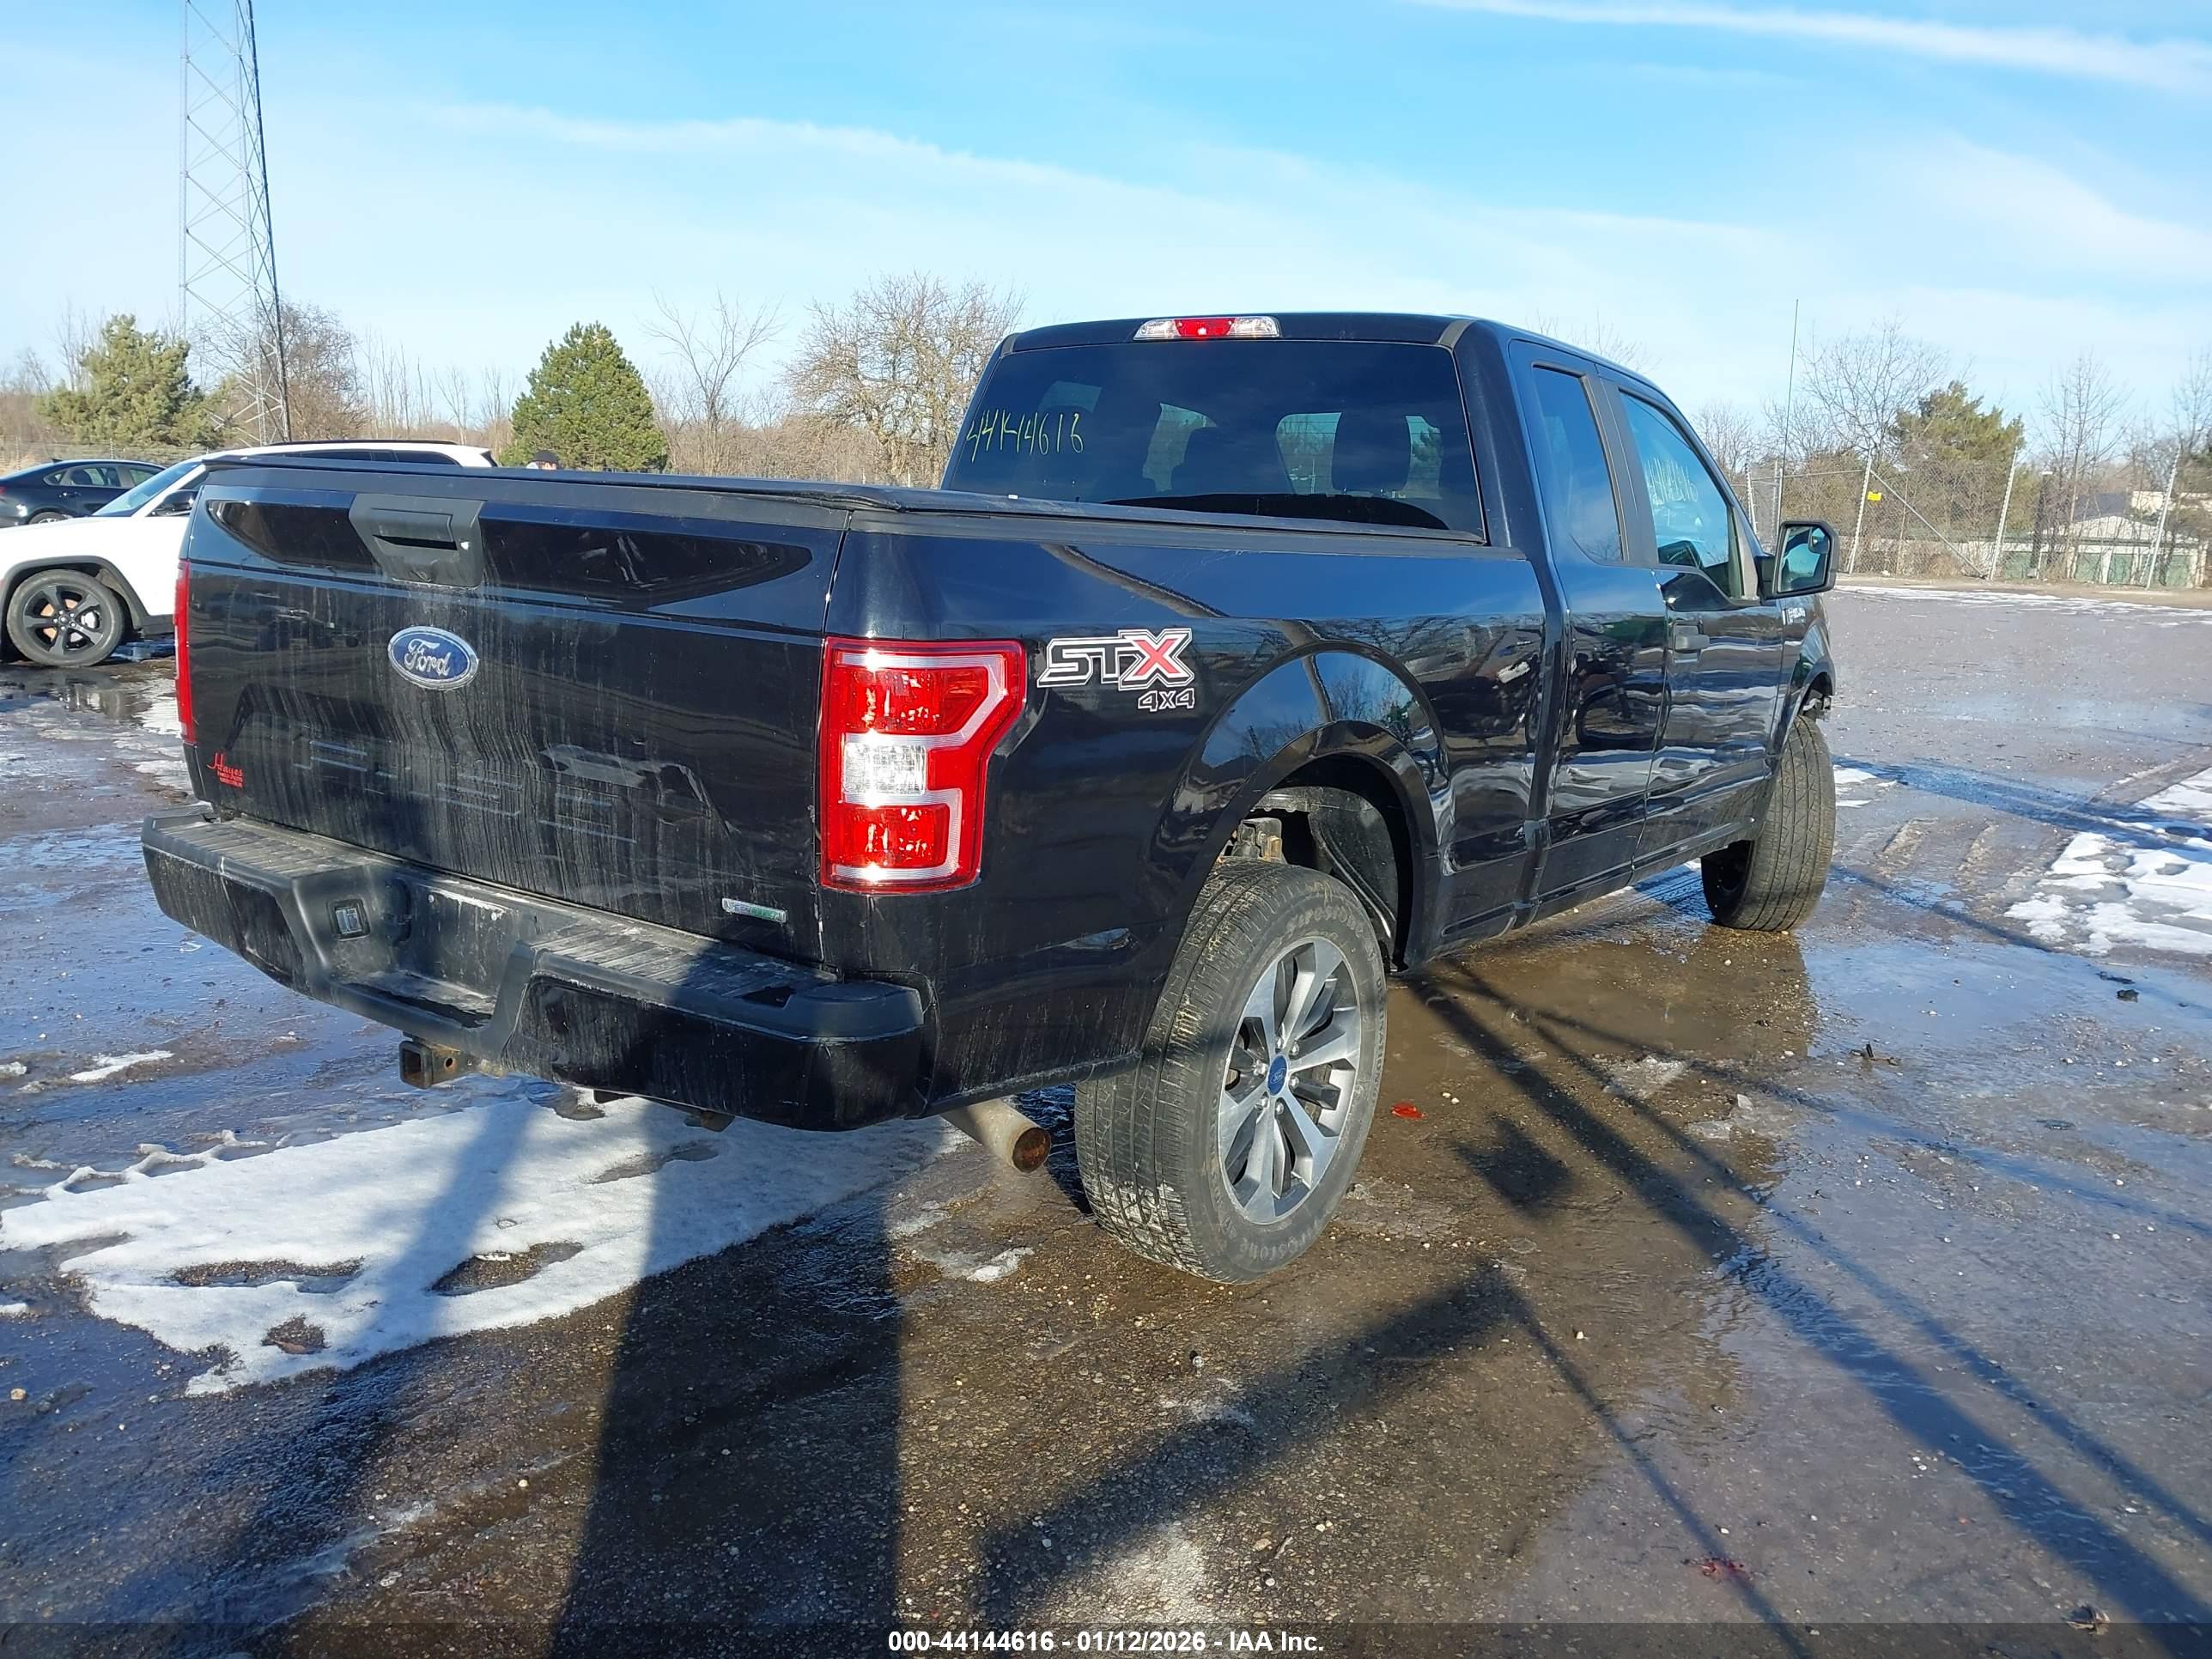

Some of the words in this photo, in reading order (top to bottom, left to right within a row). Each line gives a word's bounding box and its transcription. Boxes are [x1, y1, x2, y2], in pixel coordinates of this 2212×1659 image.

[404, 638, 452, 676] Ford
[1037, 628, 1194, 691] STX
[206, 752, 243, 777] Hayes
